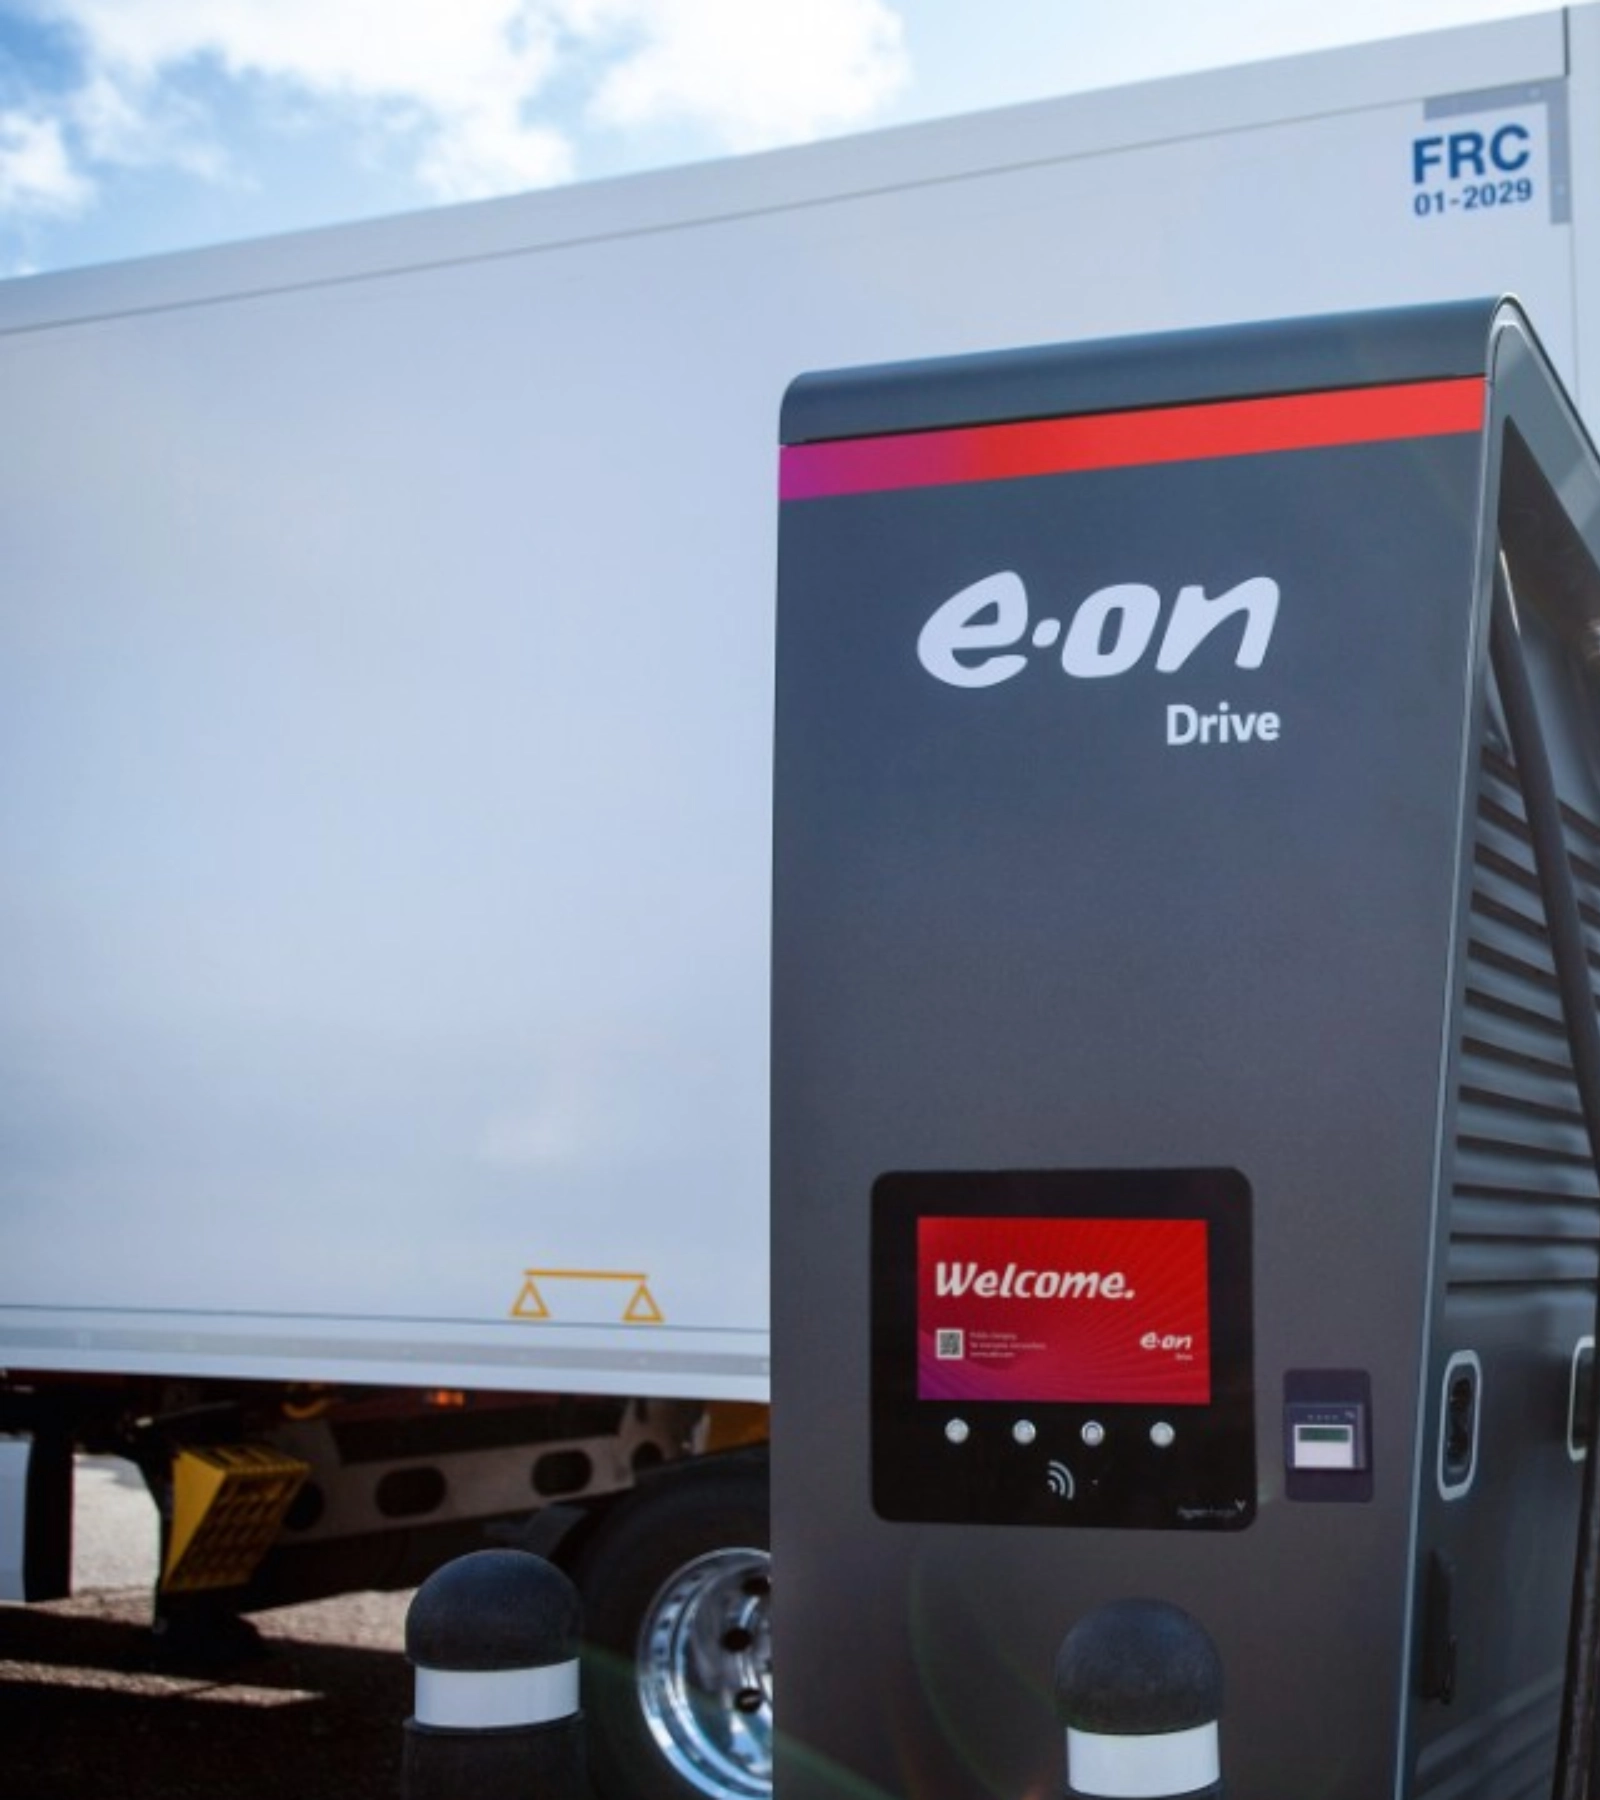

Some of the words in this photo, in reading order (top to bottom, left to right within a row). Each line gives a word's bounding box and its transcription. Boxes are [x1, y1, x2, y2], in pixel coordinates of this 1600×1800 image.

[1412, 123, 1531, 184] FRC
[1413, 177, 1533, 216] 01-2029
[1166, 701, 1281, 746] Drive
[935, 1261, 1136, 1300] Welcome.
